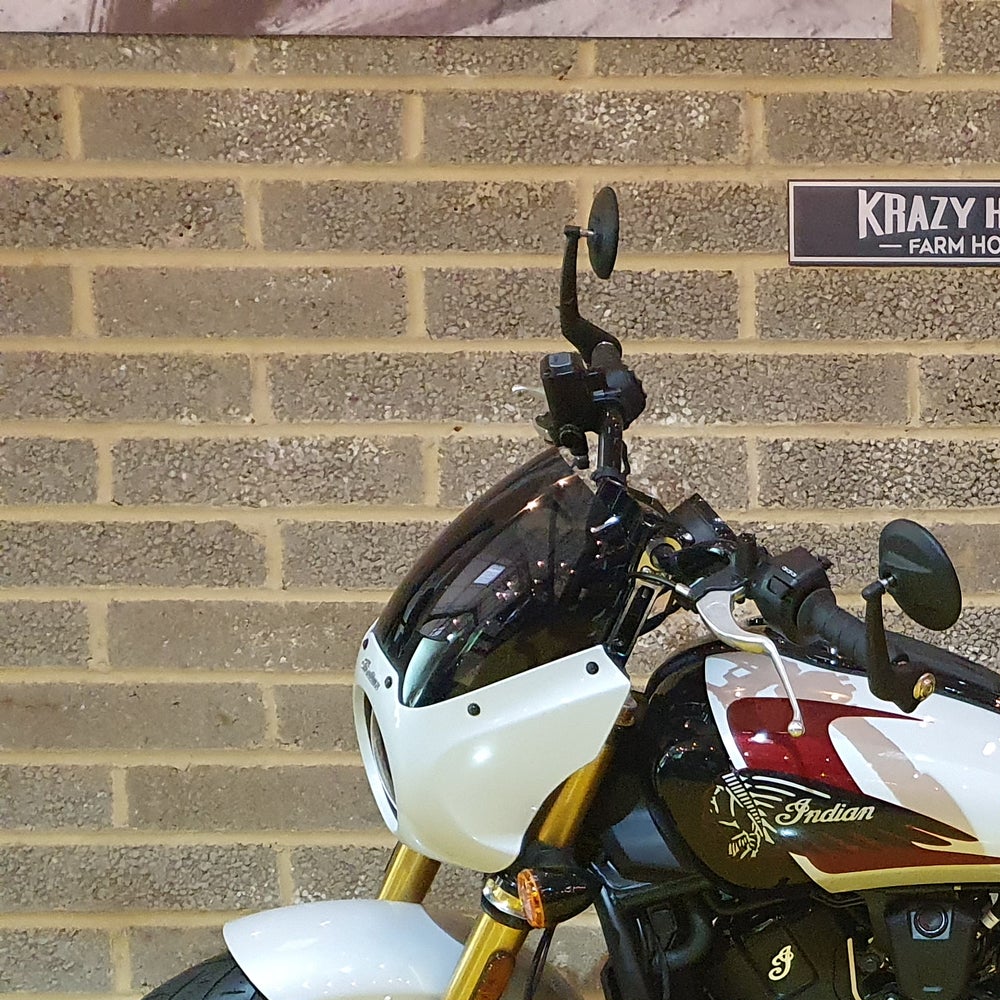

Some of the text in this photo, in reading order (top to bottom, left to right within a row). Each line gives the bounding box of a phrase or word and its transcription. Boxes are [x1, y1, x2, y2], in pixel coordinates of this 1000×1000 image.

[858, 189, 976, 239] KRAZY
[909, 236, 965, 255] FARM
[774, 798, 876, 826] Indian
